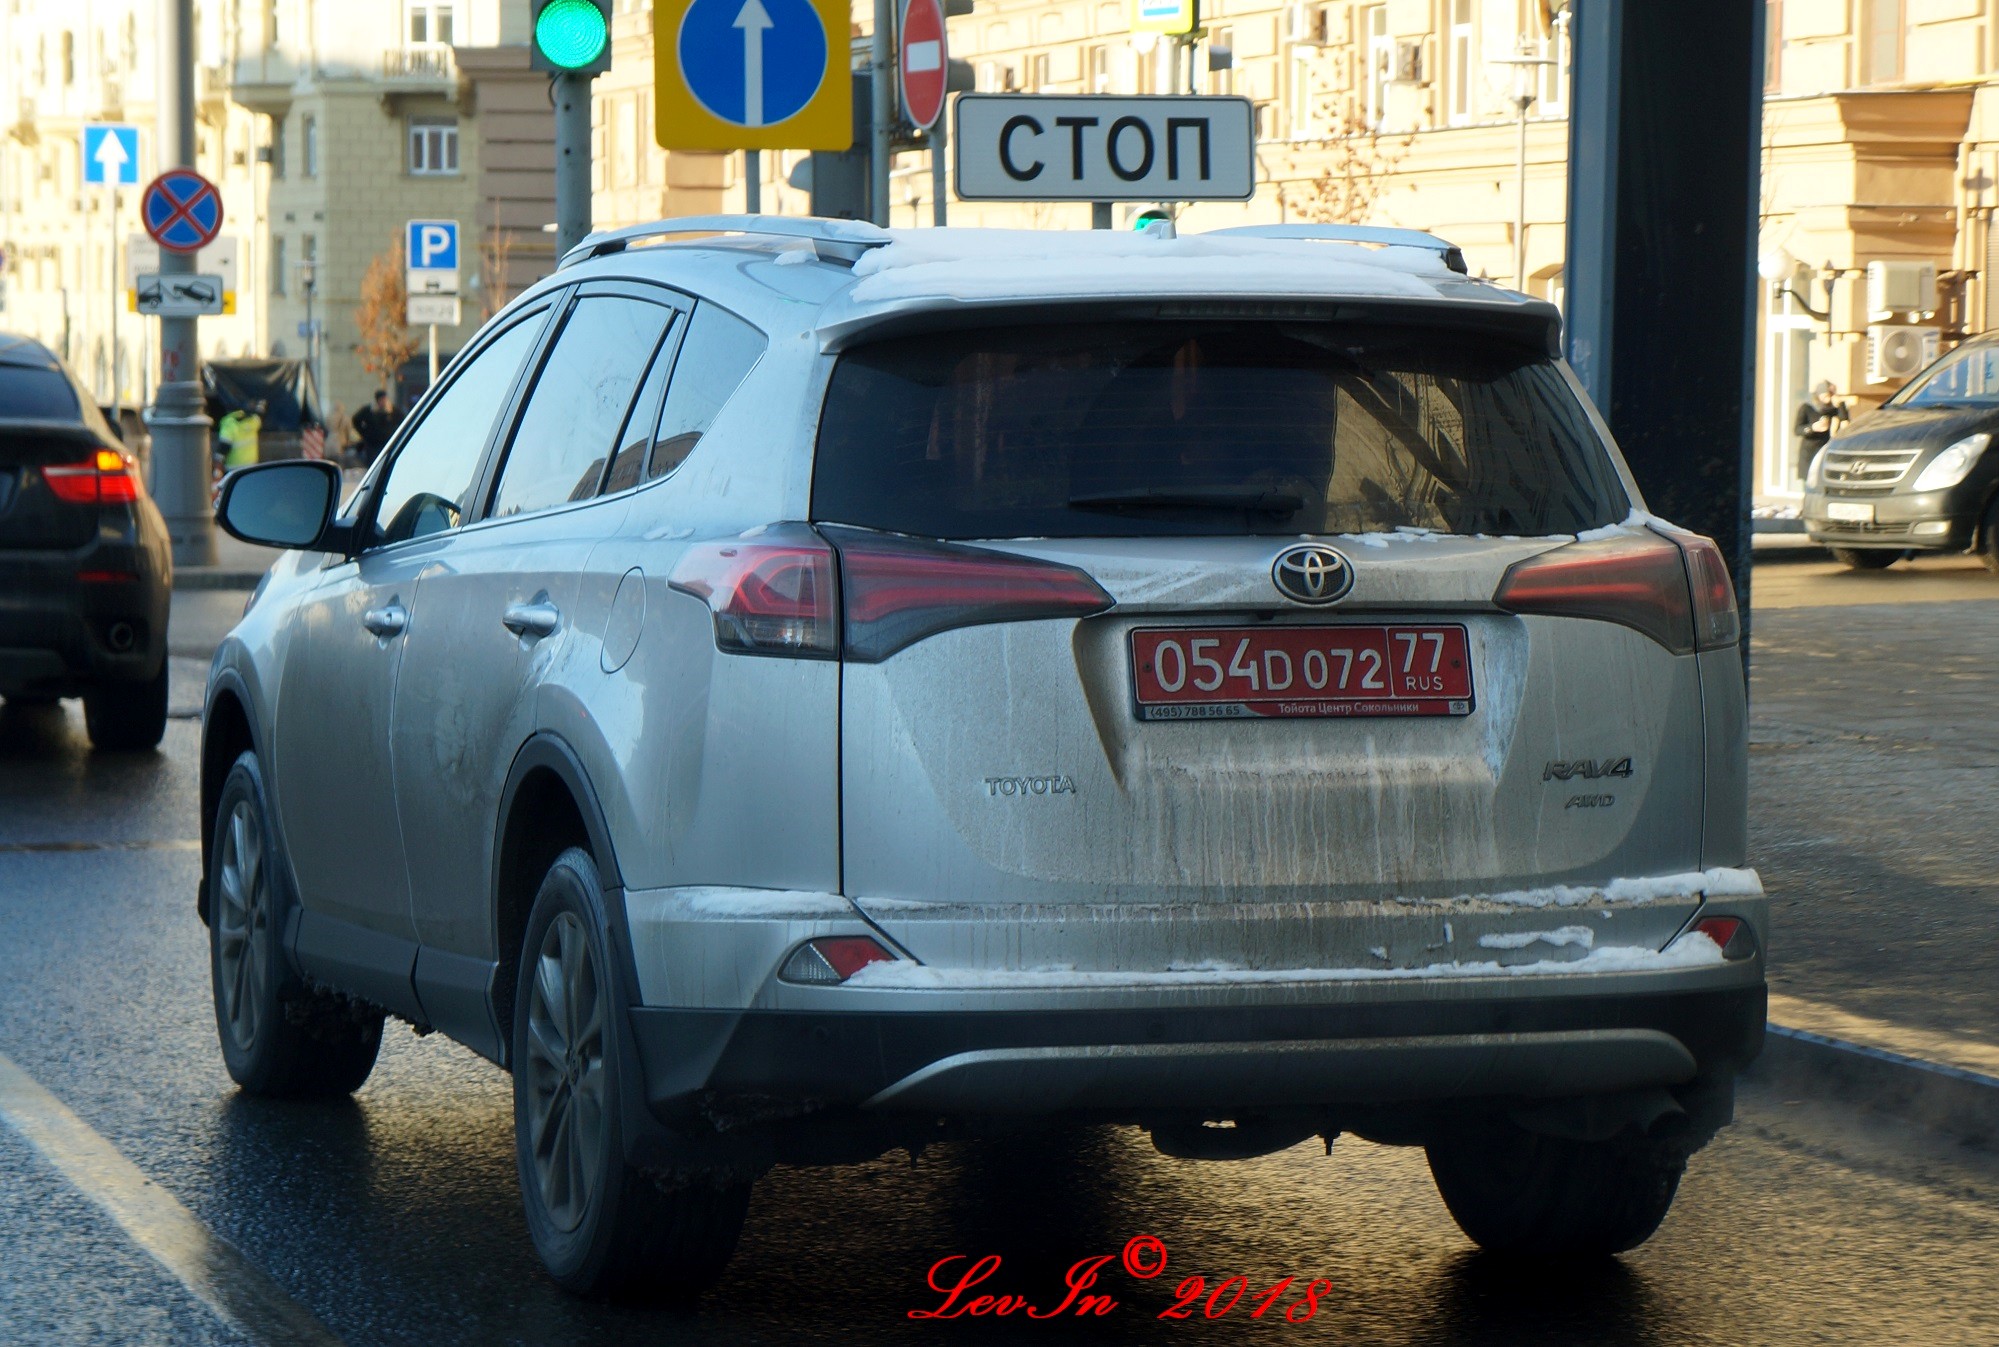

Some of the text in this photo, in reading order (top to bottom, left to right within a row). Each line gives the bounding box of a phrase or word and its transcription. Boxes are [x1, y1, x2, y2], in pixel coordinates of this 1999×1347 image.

[999, 114, 1211, 182] СТОП
[421, 226, 450, 267] P
[1395, 632, 1445, 673] 77
[1405, 676, 1444, 691] RUS
[1185, 705, 1206, 717] 788
[1208, 705, 1223, 717] 56
[1225, 705, 1240, 716] 65
[1278, 702, 1419, 715] Тойота Центр Сокольники
[1543, 757, 1633, 781] RAV4
[985, 776, 1076, 796] TOYOTA
[1565, 794, 1615, 810] AWD
